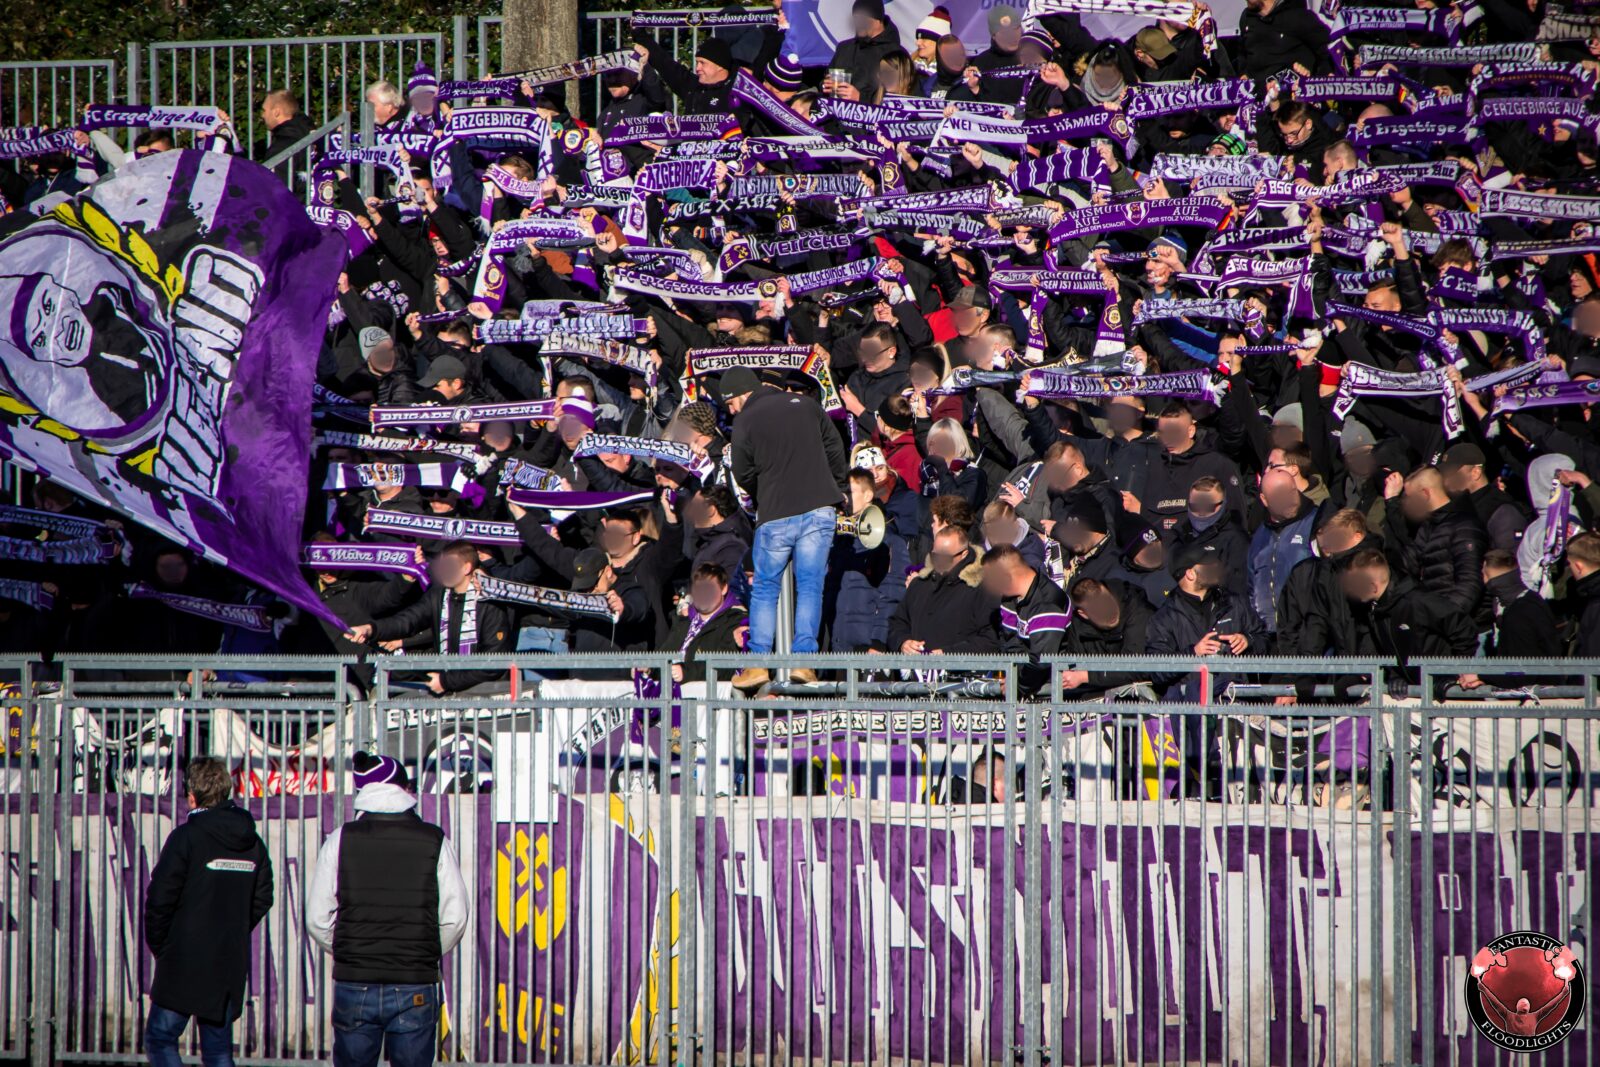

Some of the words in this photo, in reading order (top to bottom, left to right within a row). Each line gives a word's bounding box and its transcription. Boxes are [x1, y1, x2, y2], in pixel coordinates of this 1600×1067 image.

[1148, 86, 1232, 109] WISMUT
[1305, 82, 1395, 97] BUNDESLIGA
[1439, 93, 1463, 106] WIR
[84, 110, 102, 125] FC
[104, 109, 184, 123] Erzgebirge
[184, 111, 216, 126] Aue
[1493, 101, 1561, 116] ERZGEBIRGE
[1562, 102, 1586, 119] AUE
[452, 112, 529, 129] ERZGEBIRGE
[979, 122, 1051, 137] GEKREUZTE
[1055, 111, 1109, 131] HÄMMER
[1376, 121, 1457, 137] Erzgebirge
[628, 125, 649, 135] AUE
[855, 139, 887, 154] Aue
[1268, 181, 1293, 195] BSG
[1151, 196, 1226, 209] ERZGEBIRGE
[1172, 206, 1199, 216] AUE
[1069, 203, 1122, 220] WISMUT
[874, 212, 898, 226] BSG
[897, 212, 955, 231] WISMUT
[958, 217, 984, 237] AUE
[1074, 216, 1100, 228] AUE
[1160, 215, 1180, 223] STOLZ
[1191, 215, 1219, 227] SACHSEN
[1061, 230, 1079, 239] MACHT
[1090, 224, 1102, 232] DEM
[1102, 221, 1126, 230] SCHACHT
[761, 233, 853, 258] VEILCHEN
[801, 265, 848, 286] ERZGEBIRGE
[848, 260, 867, 275] AUE
[1225, 258, 1249, 275] BSG
[618, 268, 634, 284] FC
[639, 273, 722, 296] ERZGEBIRGE
[726, 281, 756, 297] AUE
[1059, 280, 1072, 290] IST
[1072, 280, 1108, 291] LILAWEIS
[1441, 308, 1510, 326] WISMUT
[541, 332, 603, 354] ISMUT
[694, 353, 774, 370] Erzgebirge
[380, 411, 452, 421] BRIGADE
[474, 404, 543, 418] JUGEND
[324, 430, 409, 451] WISMUT
[371, 513, 445, 529] BRIGADE
[467, 524, 520, 536] JUGE
[328, 548, 374, 562] März
[754, 711, 888, 737] FANSZENE
[893, 711, 942, 732] BSG
[484, 982, 565, 1055] AUE
